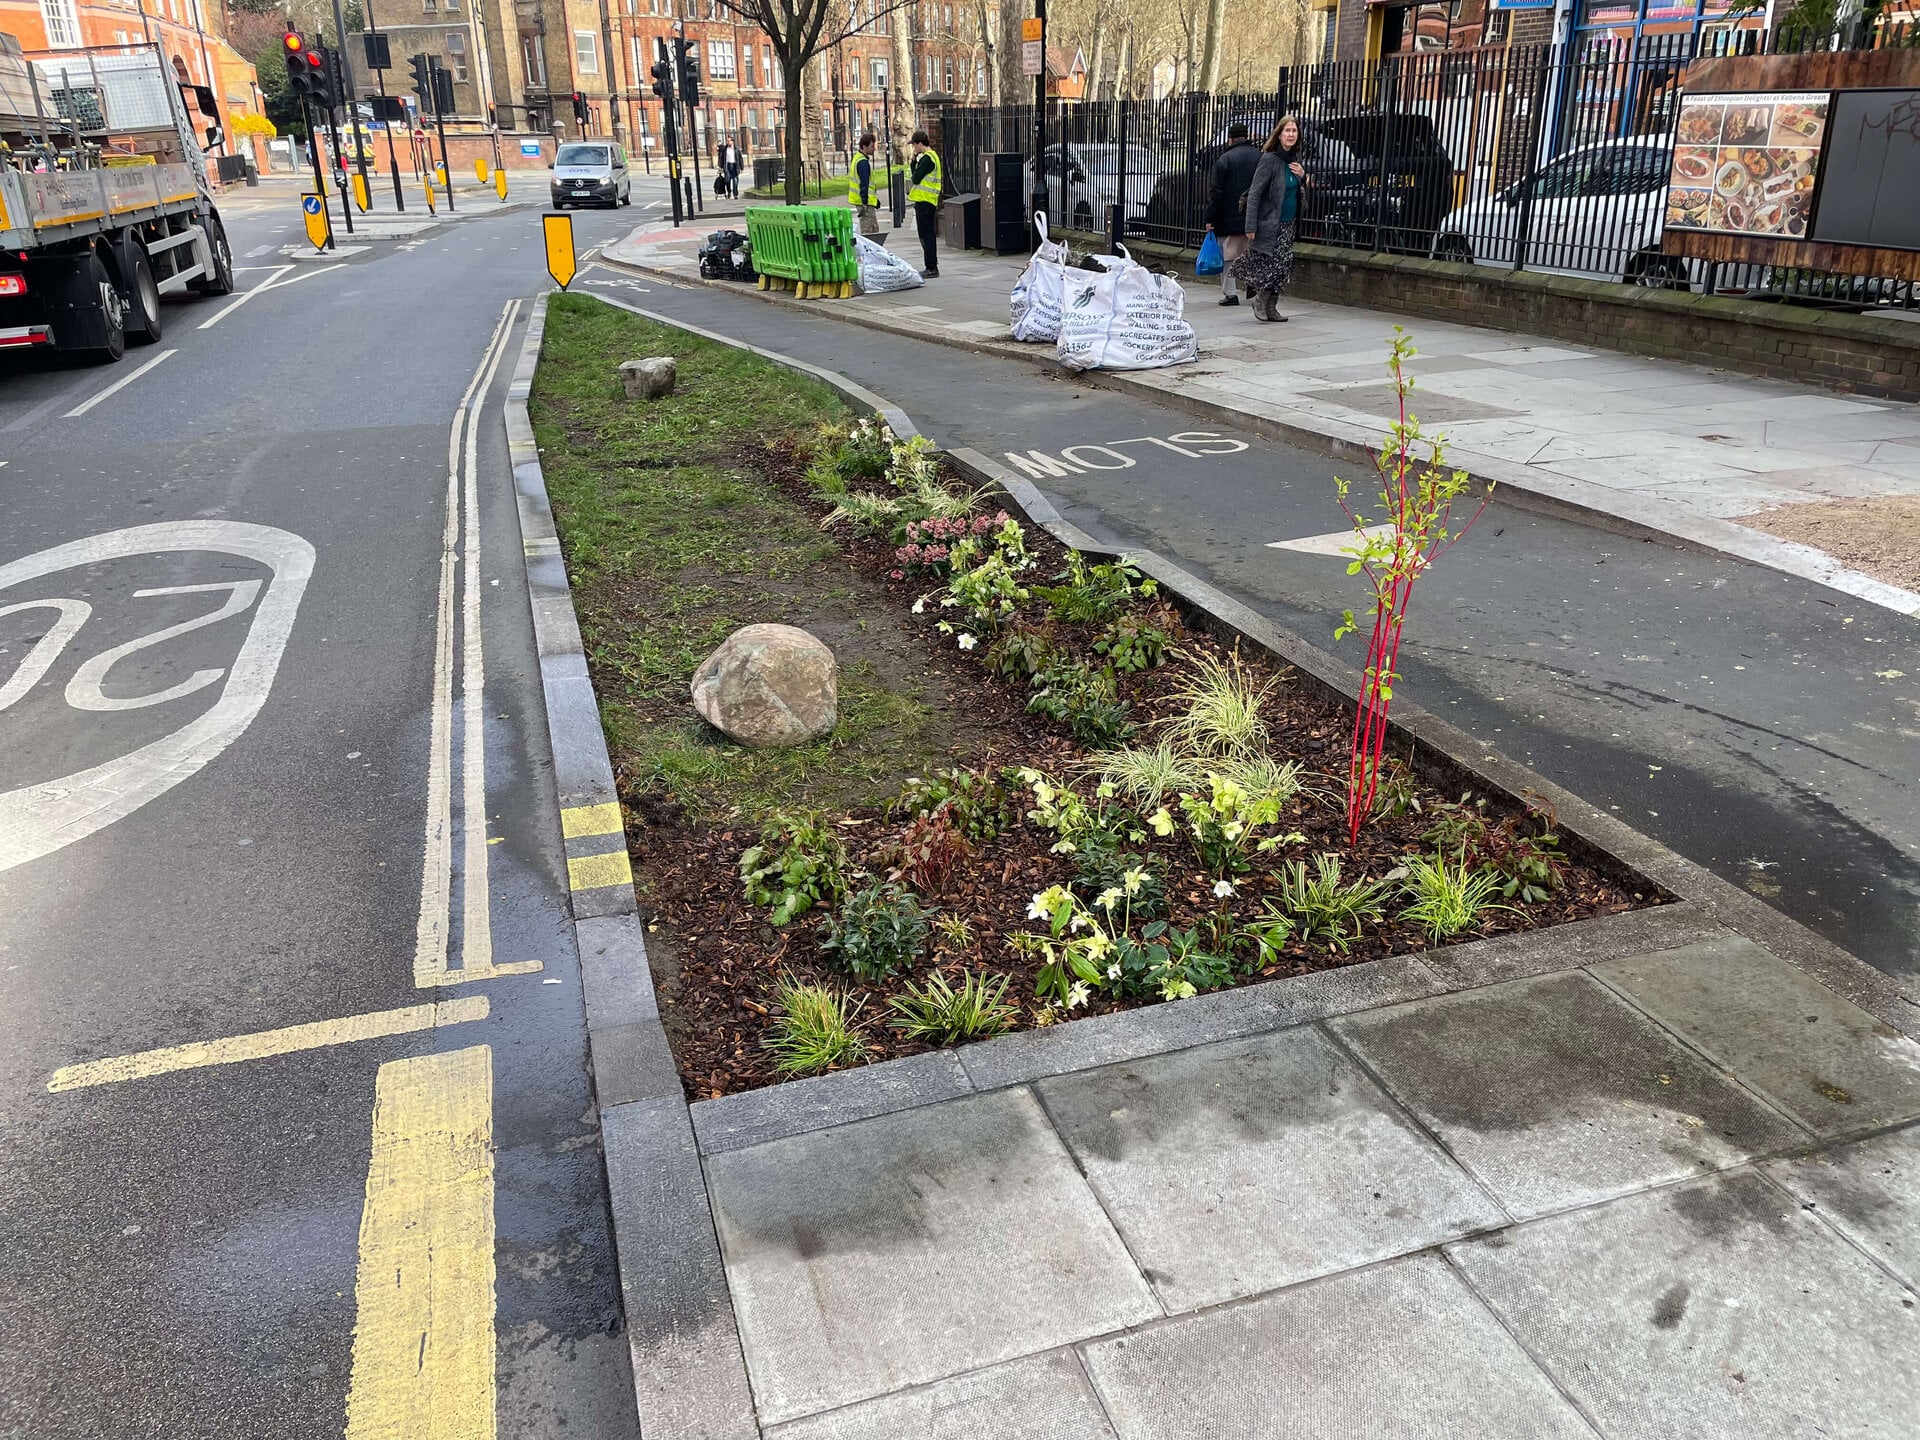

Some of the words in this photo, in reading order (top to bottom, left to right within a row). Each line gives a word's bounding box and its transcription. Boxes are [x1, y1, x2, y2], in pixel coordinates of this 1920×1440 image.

[1126, 312, 1161, 320] EXTERIOR
[1128, 322, 1159, 330] WALLING
[1119, 331, 1165, 342] AGGREGATES
[1122, 342, 1155, 351] ROCKERY
[1004, 431, 1250, 478] SLOW
